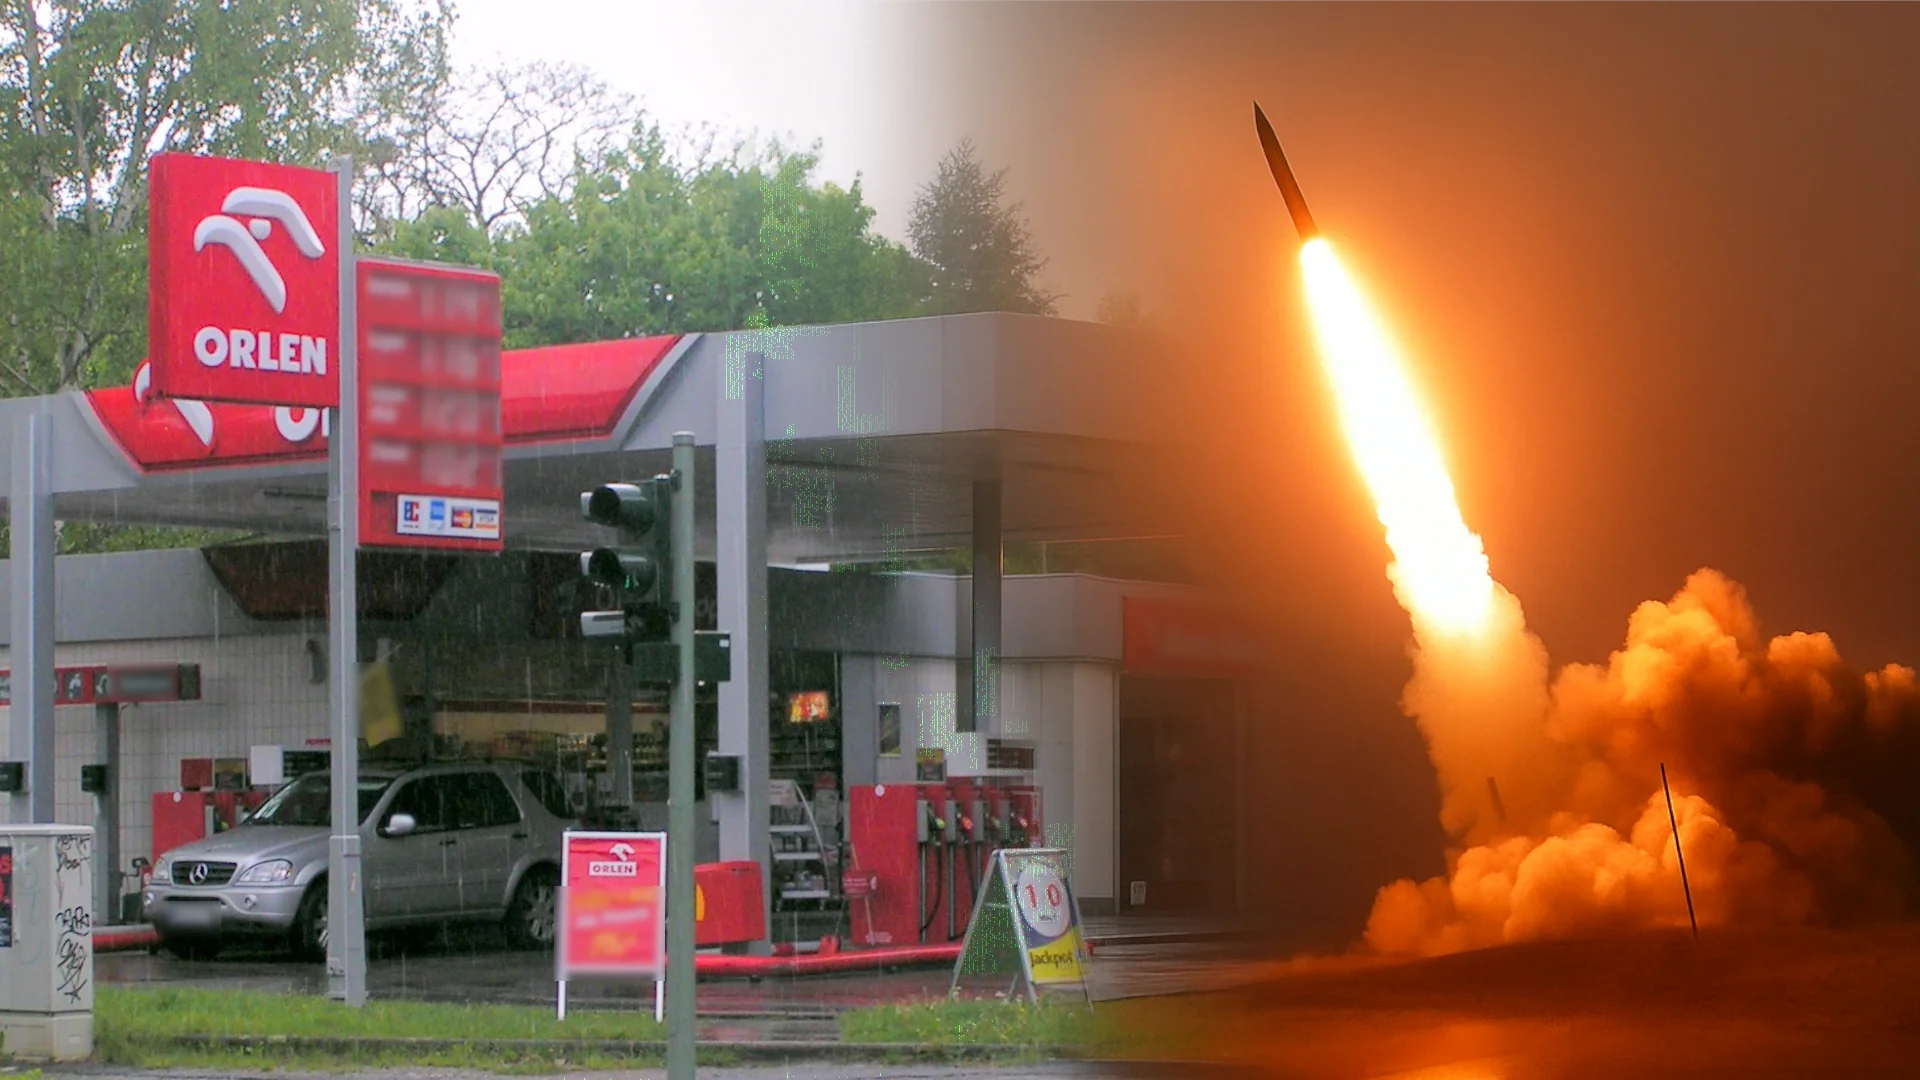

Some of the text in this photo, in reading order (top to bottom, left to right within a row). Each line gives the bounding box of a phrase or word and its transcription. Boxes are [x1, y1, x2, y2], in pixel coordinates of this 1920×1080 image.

[194, 326, 327, 375] ORLEN
[275, 405, 330, 442] O
[592, 864, 634, 874] ORLEN
[1029, 949, 1073, 968] Jackpot
